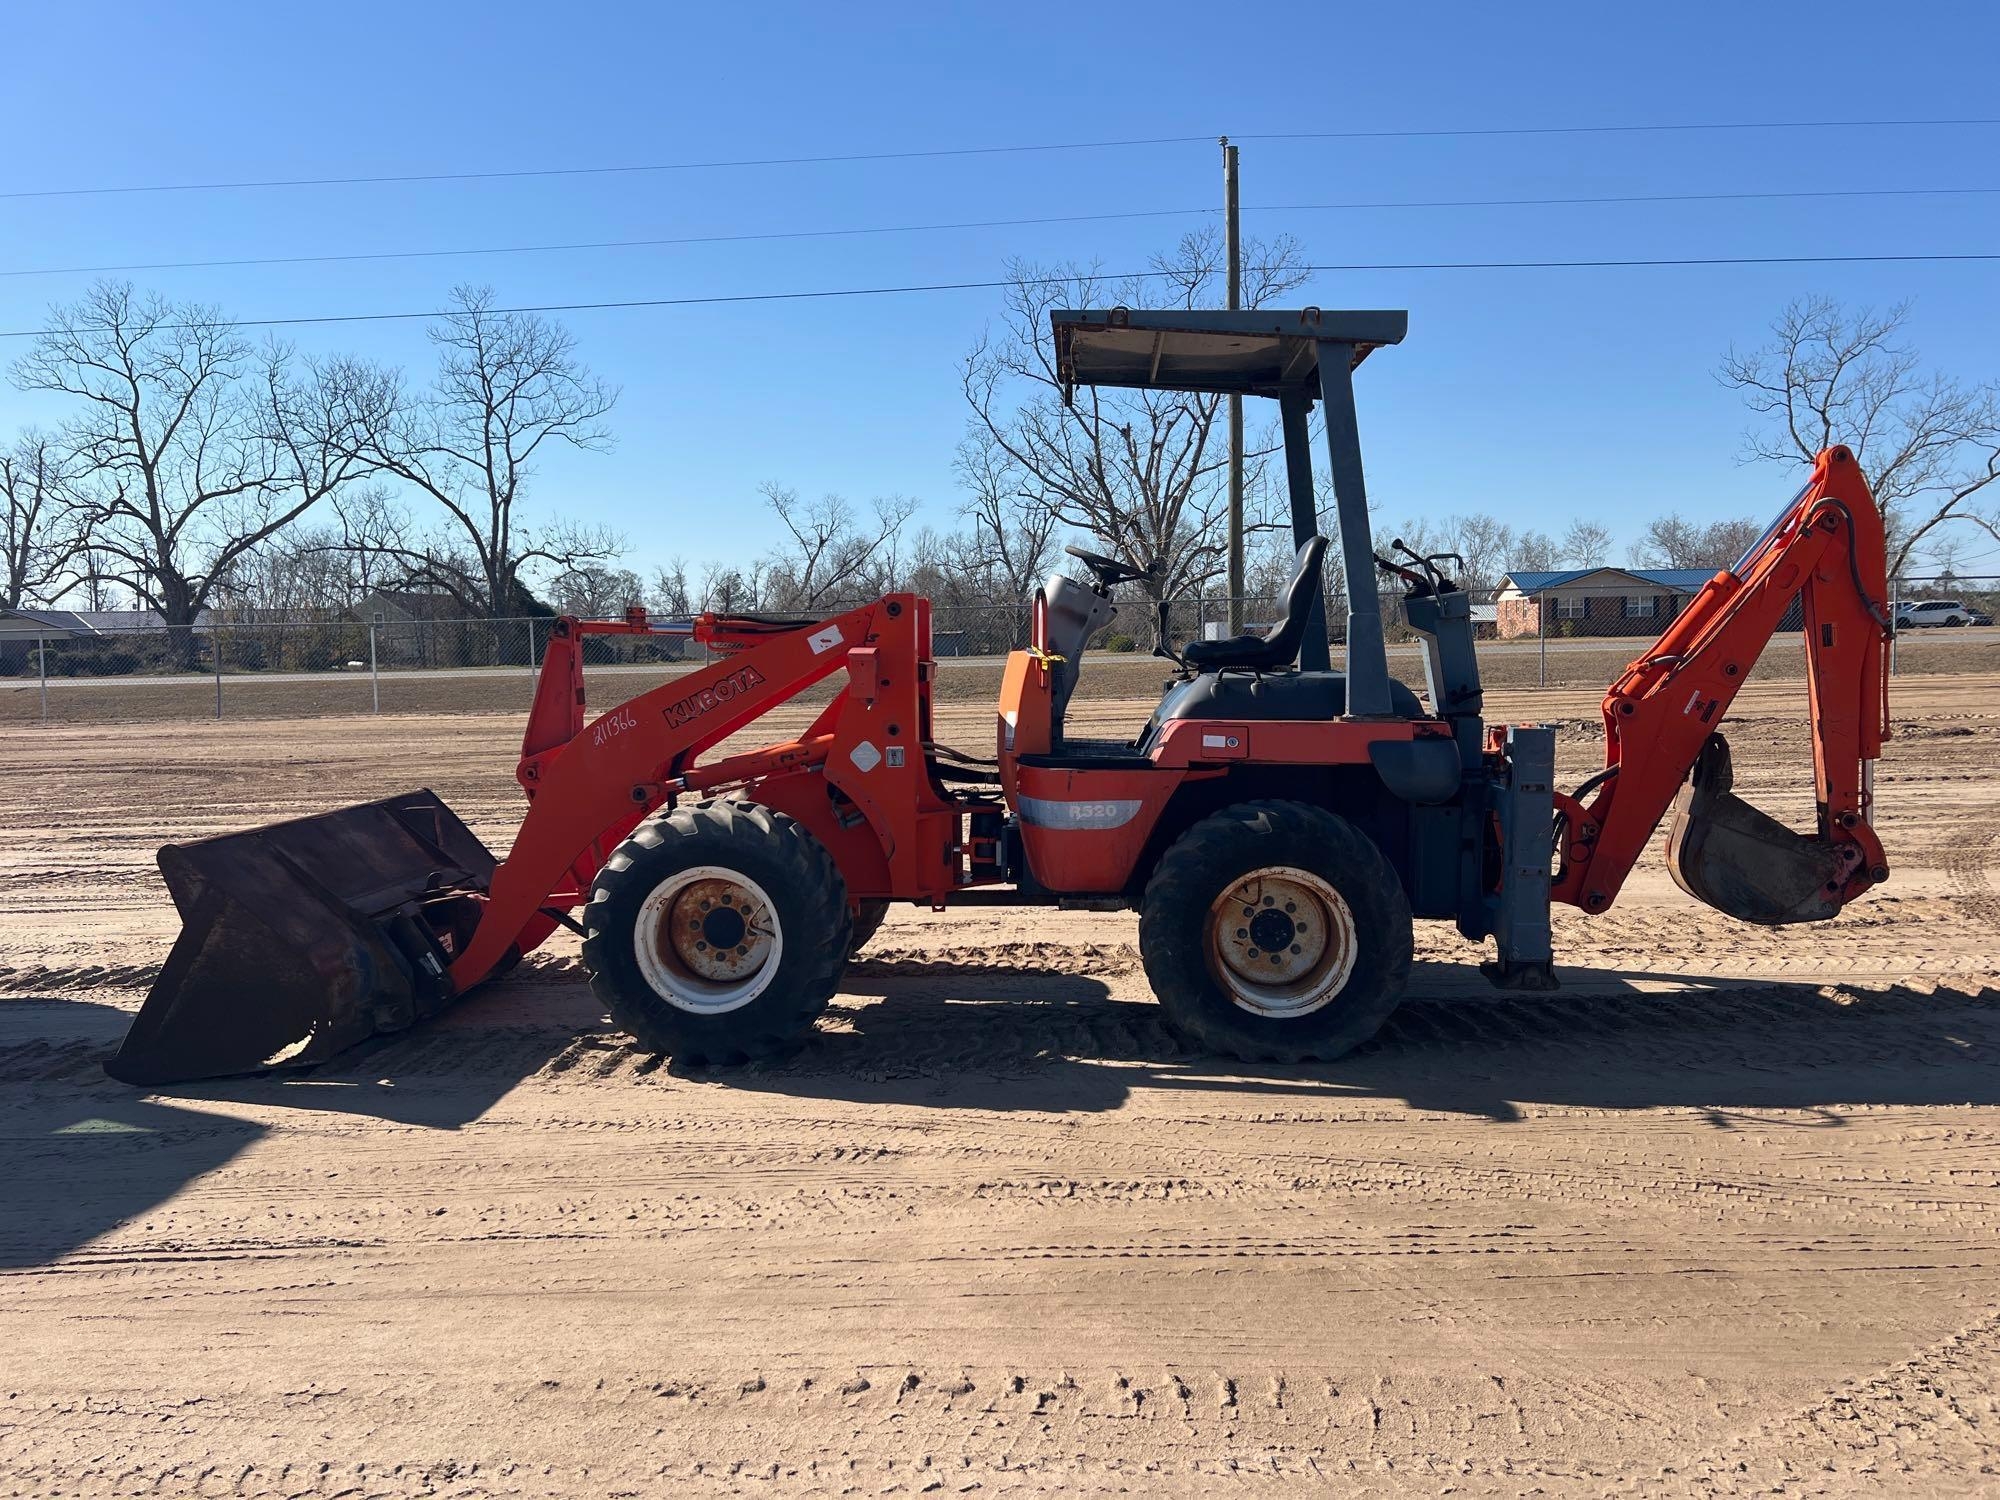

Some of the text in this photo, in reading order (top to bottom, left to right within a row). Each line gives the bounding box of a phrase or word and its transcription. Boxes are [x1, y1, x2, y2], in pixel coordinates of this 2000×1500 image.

[662, 665, 766, 729] KUBOTA
[594, 708, 637, 746] 211366
[1069, 804, 1117, 819] R520
